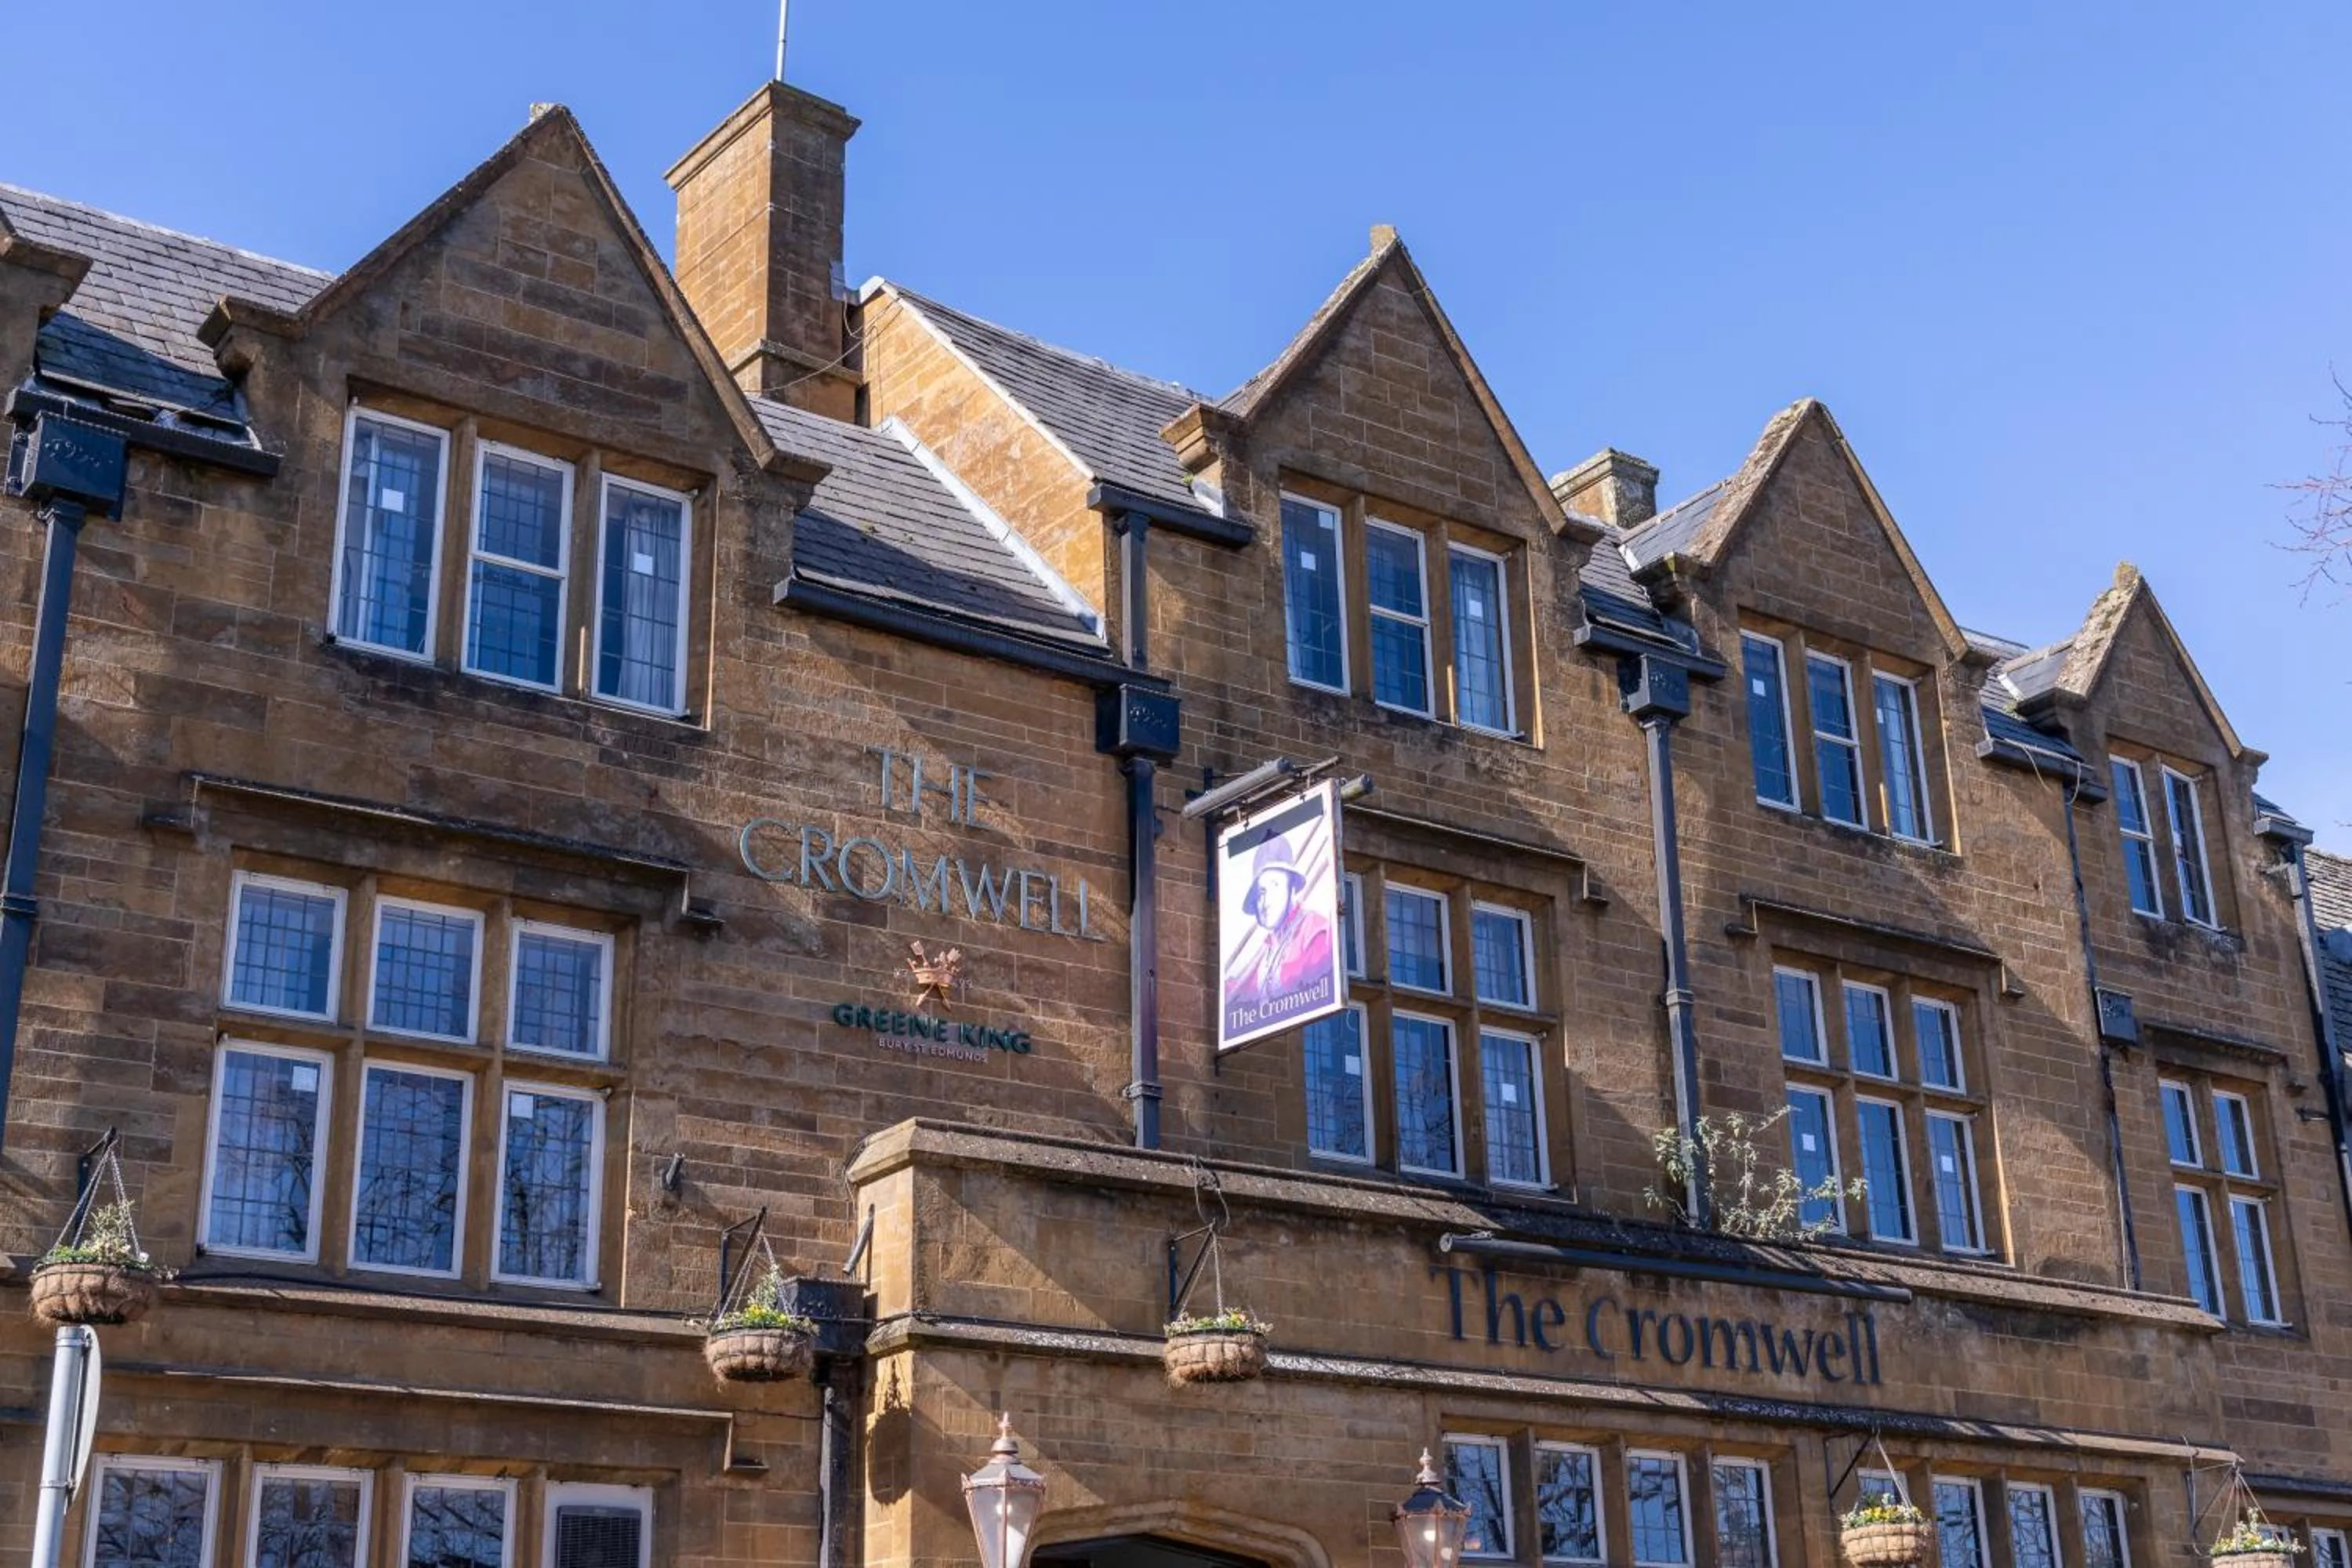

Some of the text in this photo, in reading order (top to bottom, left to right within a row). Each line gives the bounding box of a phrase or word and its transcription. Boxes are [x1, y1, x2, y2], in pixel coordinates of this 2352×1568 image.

[864, 746, 994, 829] THE
[740, 817, 1105, 942] CROMWELL
[832, 1004, 1032, 1054] GREENE KING
[1229, 977, 1328, 1029] The Cromwell
[879, 1037, 909, 1050] BURY
[931, 1046, 988, 1064] EDMUNDS
[1428, 1259, 1882, 1385] The Cromwell
